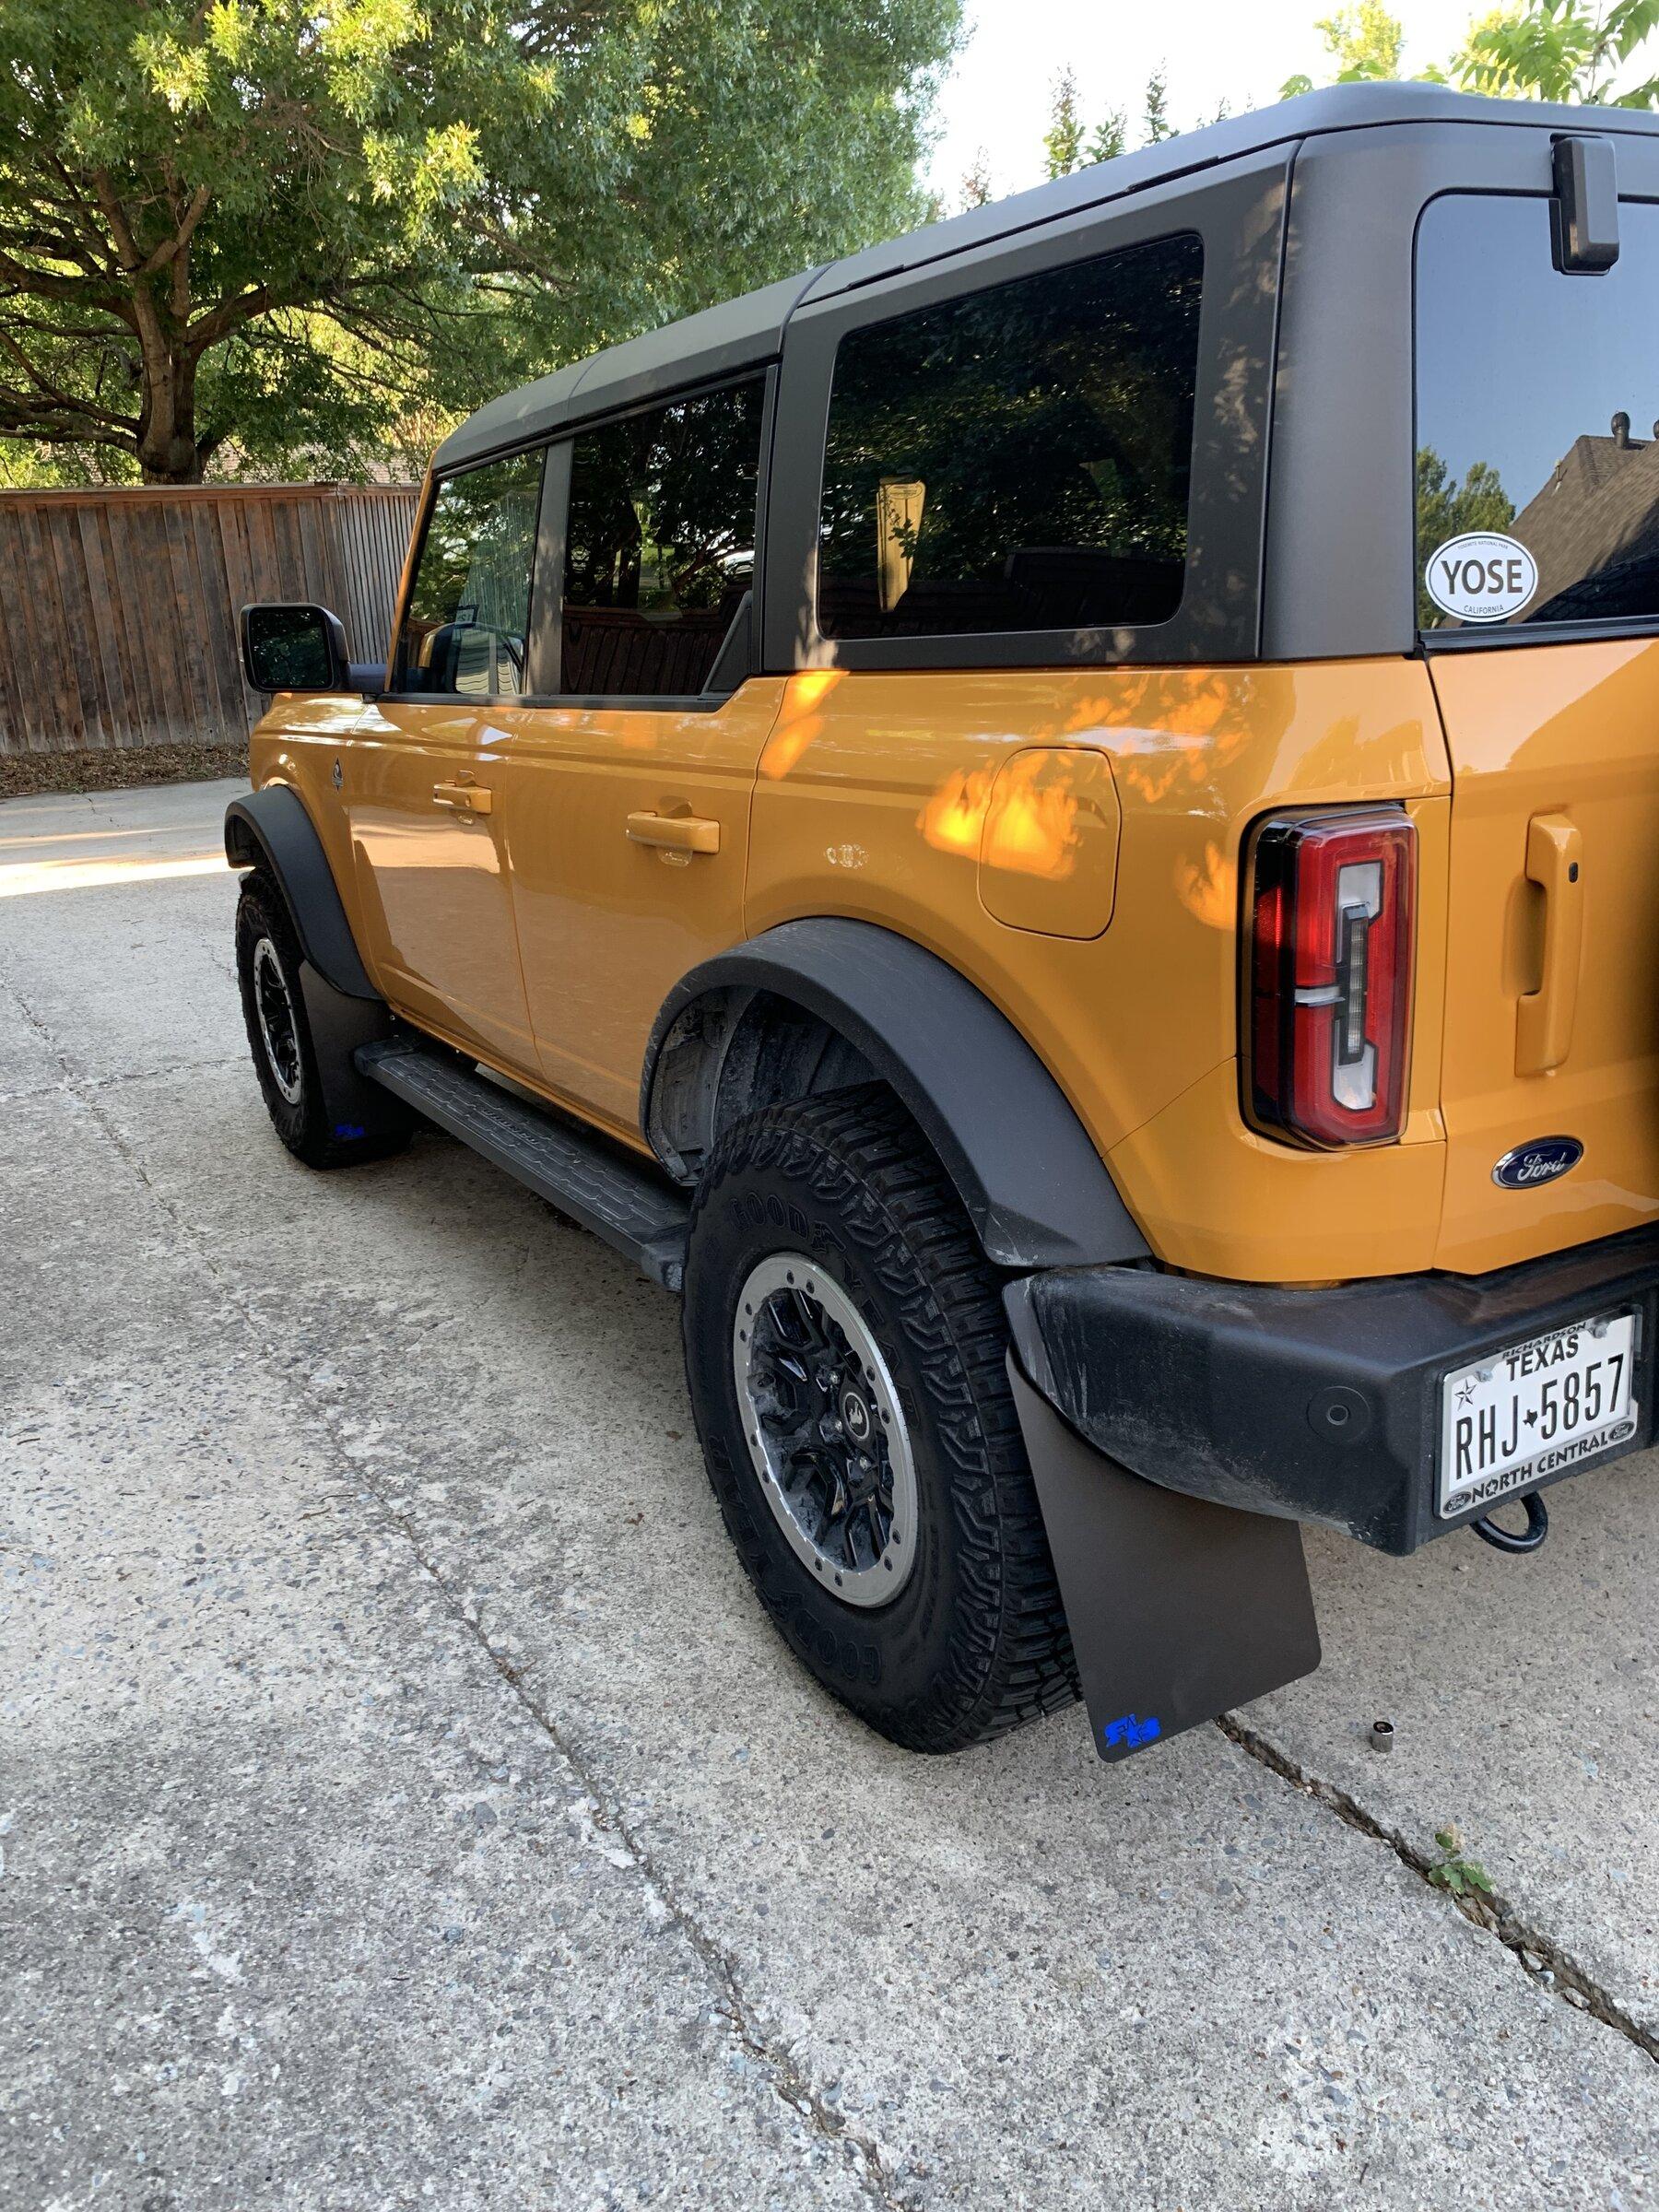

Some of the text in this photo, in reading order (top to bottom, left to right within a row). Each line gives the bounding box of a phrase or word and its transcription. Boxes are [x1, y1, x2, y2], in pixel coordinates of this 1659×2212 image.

[1441, 559, 1523, 594] YOSE
[1464, 605, 1504, 615] CALIFORNIA
[1517, 1151, 1567, 1182] Ford
[1502, 1322, 1586, 1359] RICHARDSON
[1506, 1335, 1579, 1382] TEXAS
[1472, 1431, 1608, 1503] NORTH CENTRAL
